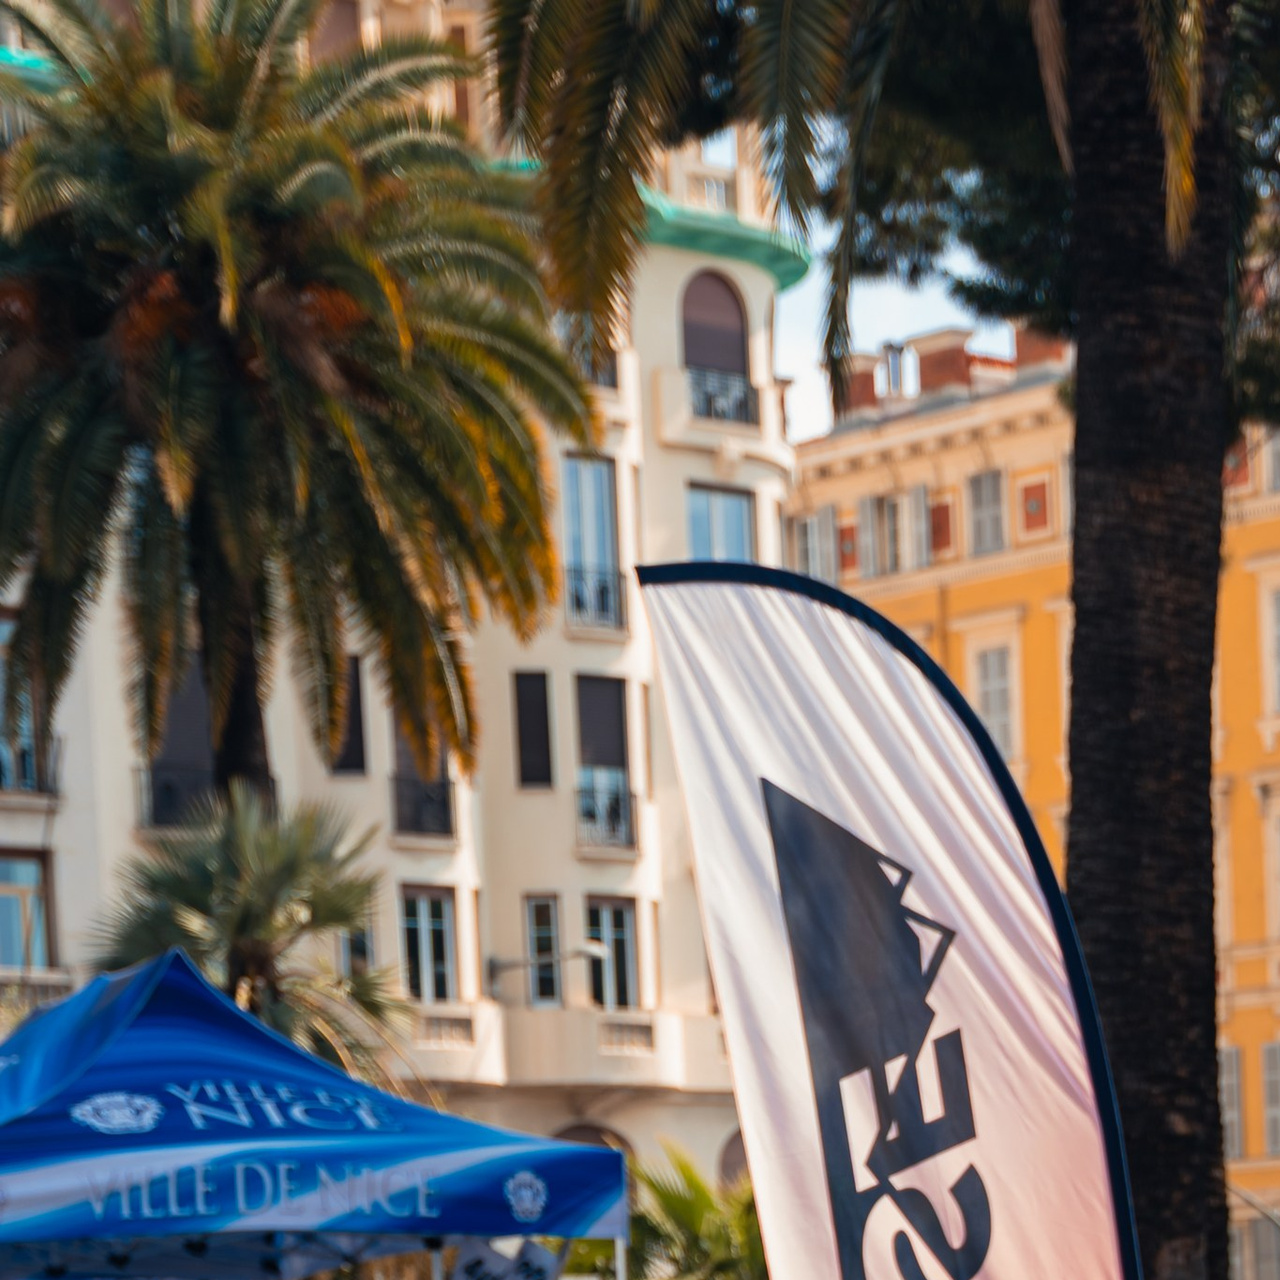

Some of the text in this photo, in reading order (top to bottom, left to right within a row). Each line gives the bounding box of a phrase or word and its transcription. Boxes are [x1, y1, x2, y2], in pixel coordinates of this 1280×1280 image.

[185, 1097, 403, 1131] NICE
[84, 1161, 442, 1221] VILLE DE NICE
